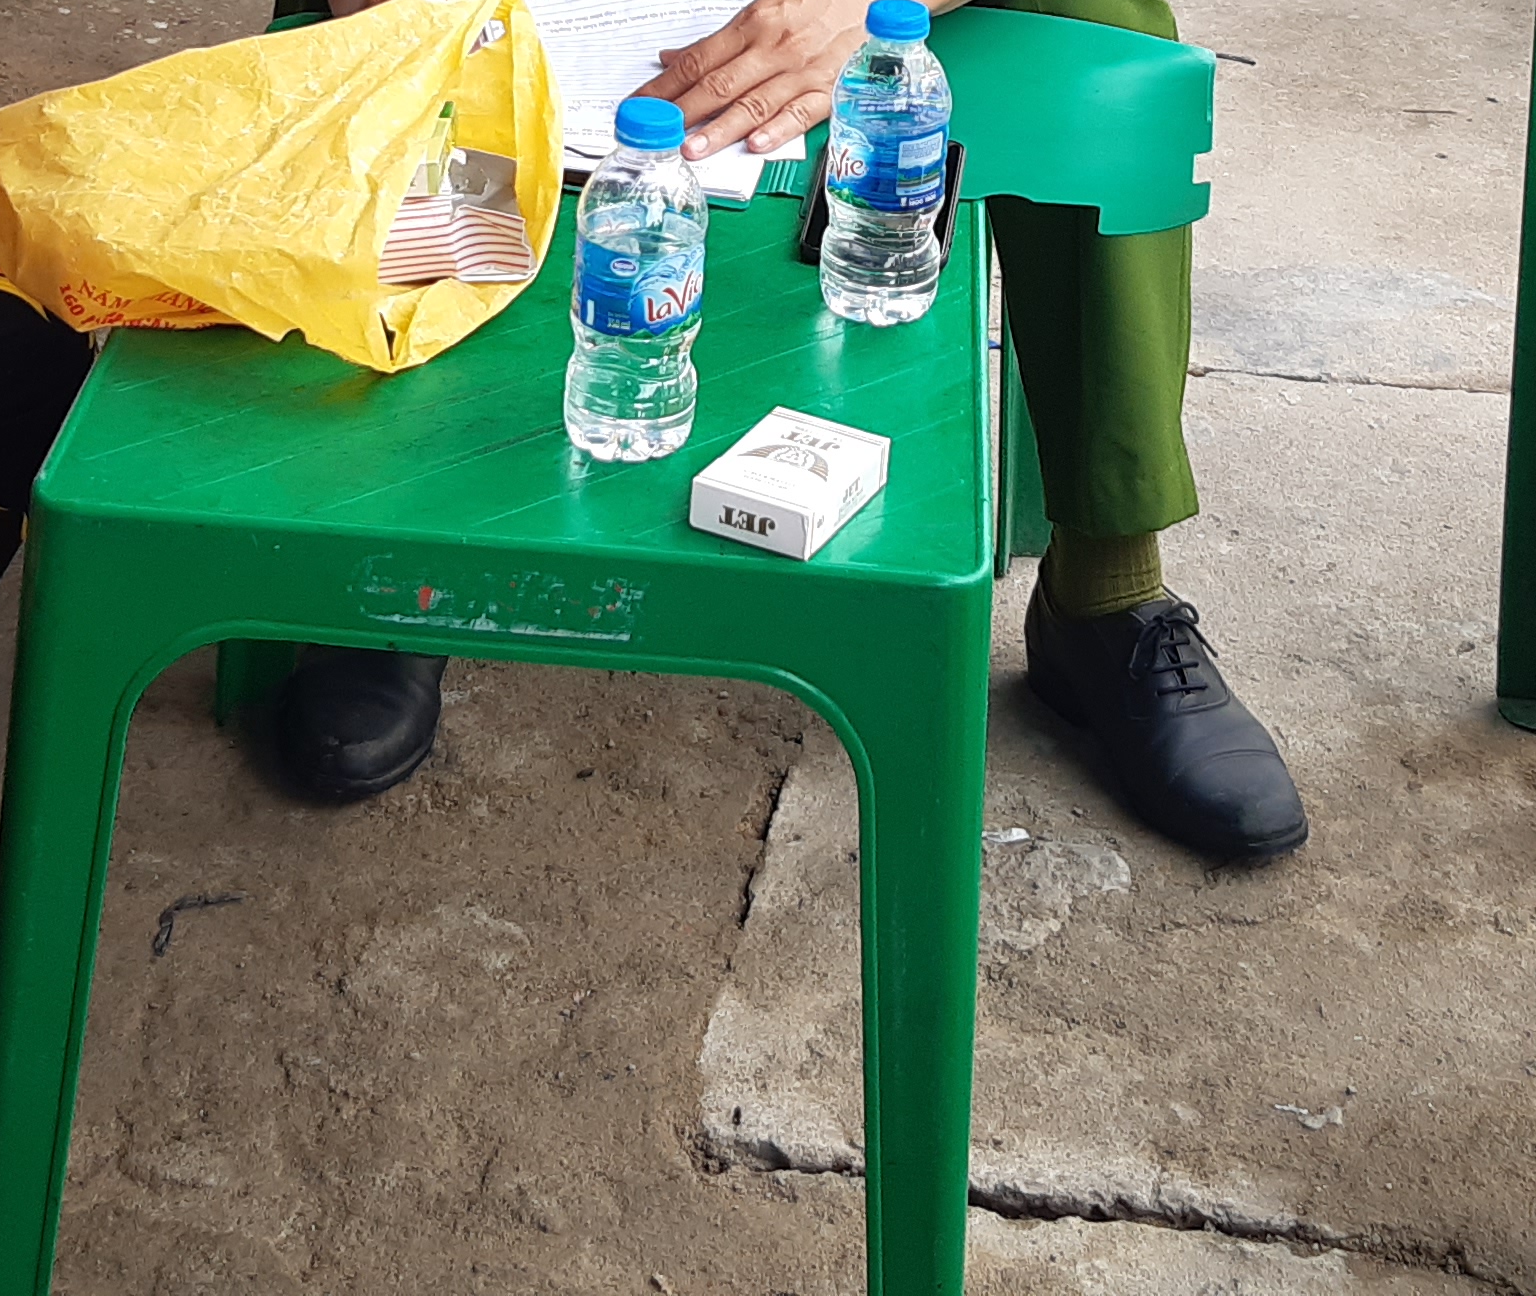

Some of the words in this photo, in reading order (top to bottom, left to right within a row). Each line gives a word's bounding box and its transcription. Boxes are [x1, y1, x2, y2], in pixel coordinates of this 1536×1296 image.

[828, 145, 865, 182] Vie
[781, 431, 841, 451] JET
[718, 504, 776, 537] JET
